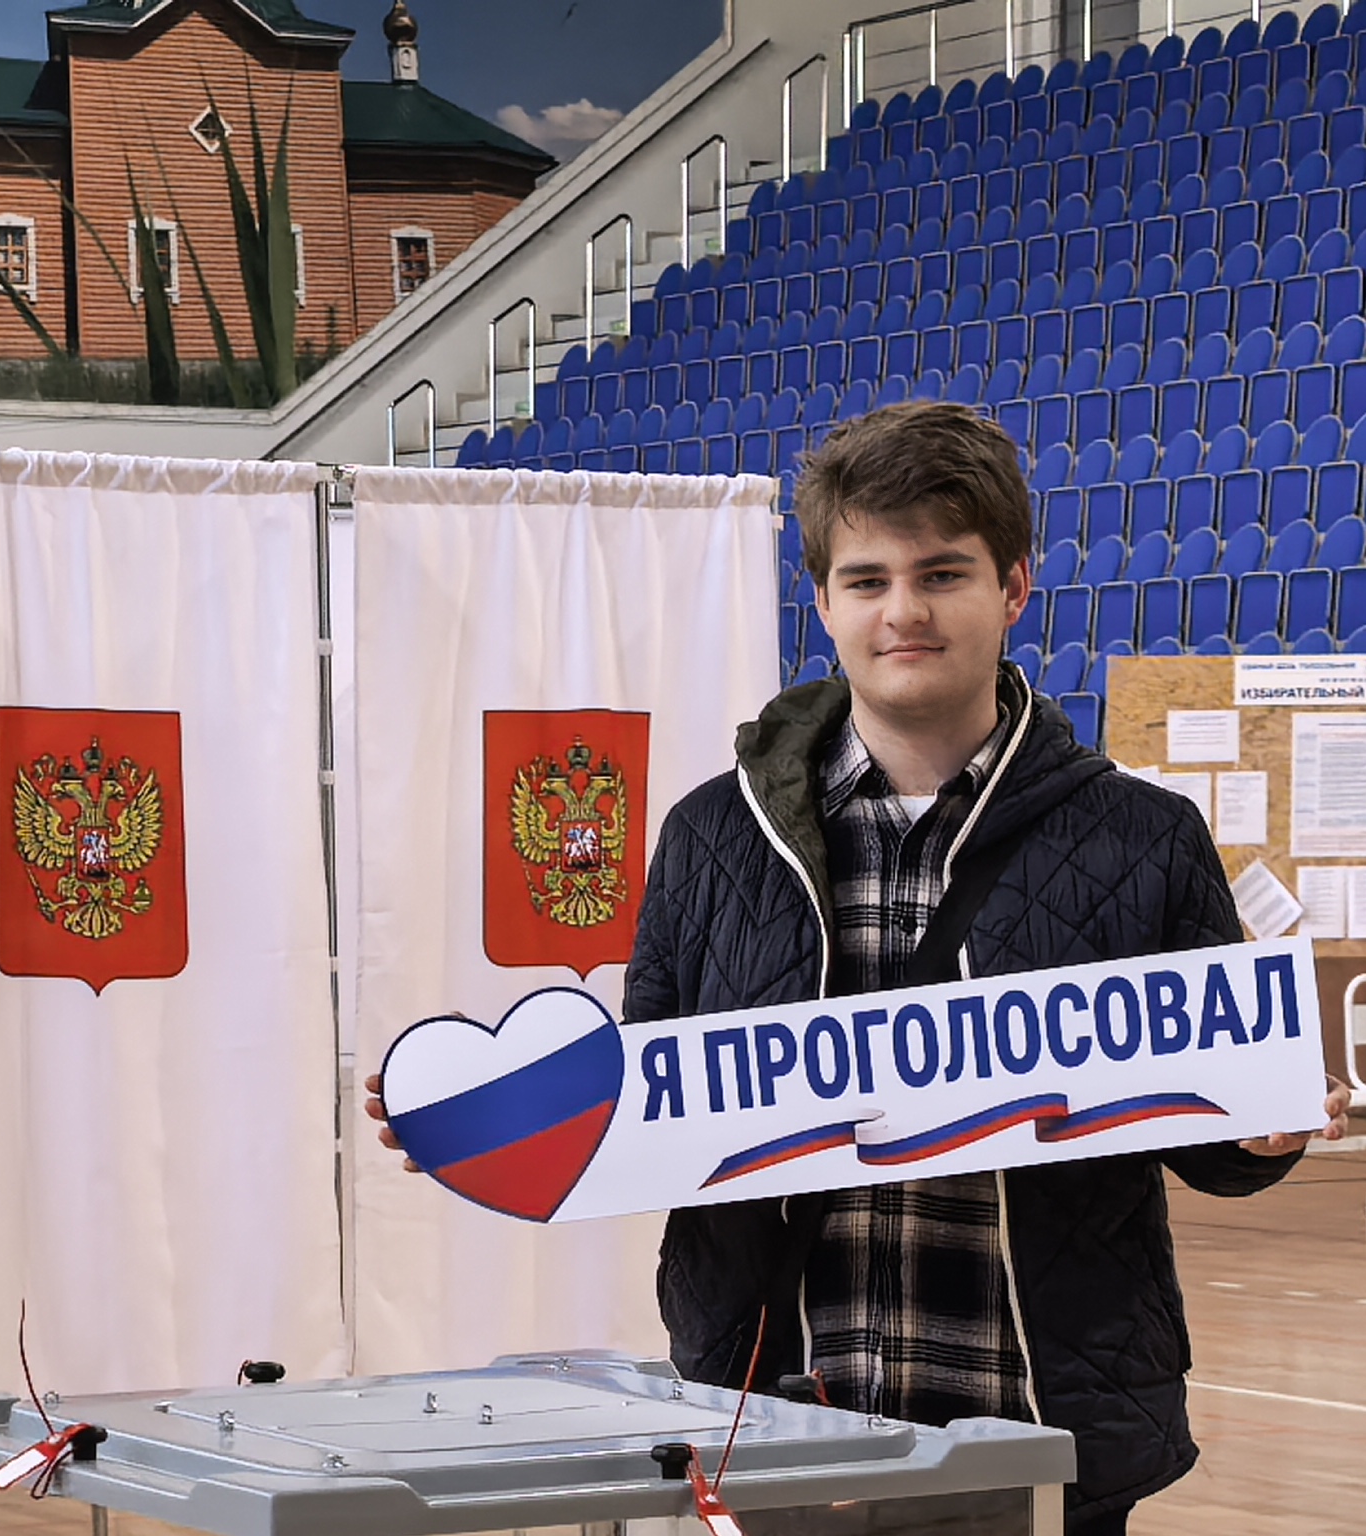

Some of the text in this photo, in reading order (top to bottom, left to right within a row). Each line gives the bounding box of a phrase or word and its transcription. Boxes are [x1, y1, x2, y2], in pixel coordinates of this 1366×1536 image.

[1241, 684, 1365, 699] ИЗБИРАТЕЛЬНЫЙ
[642, 955, 1301, 1121] Я ПРОГОЛОСОВАЛ
